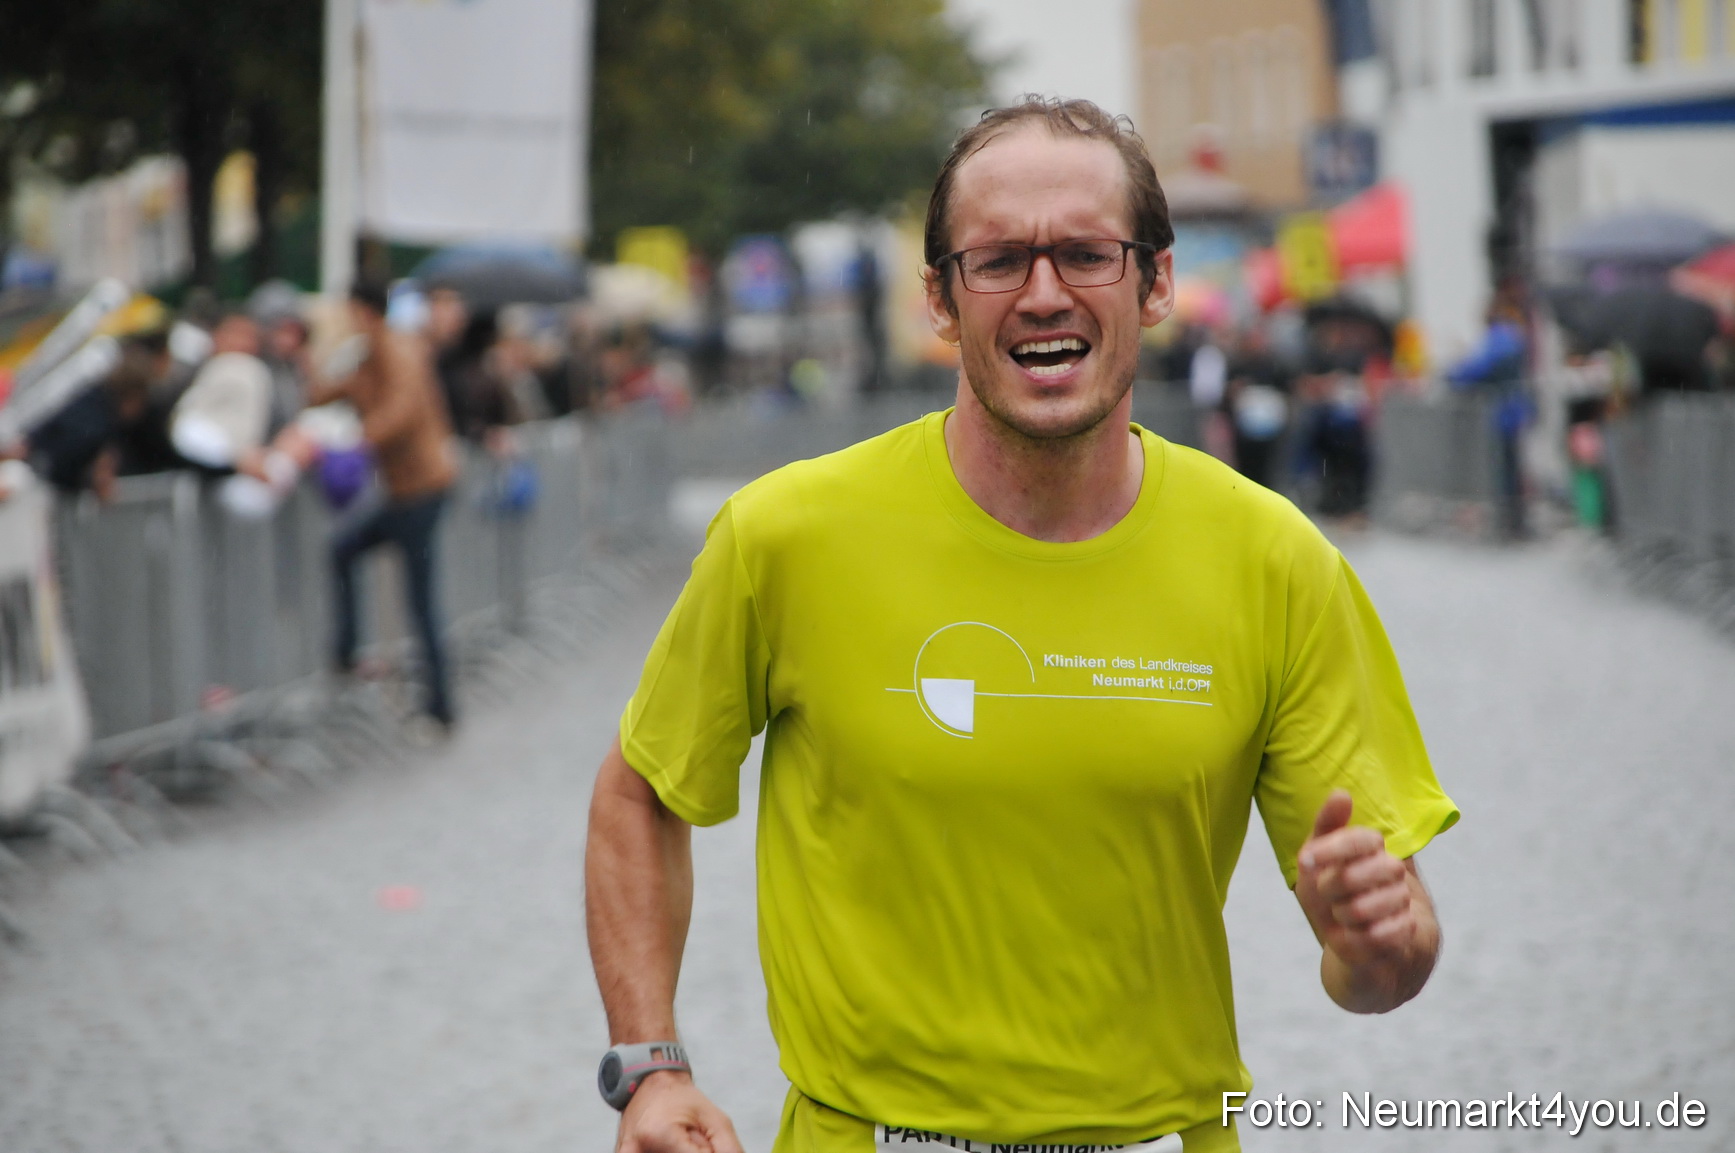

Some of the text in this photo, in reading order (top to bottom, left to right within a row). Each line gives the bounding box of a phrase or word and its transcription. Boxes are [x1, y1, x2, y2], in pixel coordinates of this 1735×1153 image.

[1043, 654, 1214, 675] Kliniken des Landkreises
[1092, 673, 1165, 689] Neumarkt
[991, 1143, 1124, 1153] Neuma
